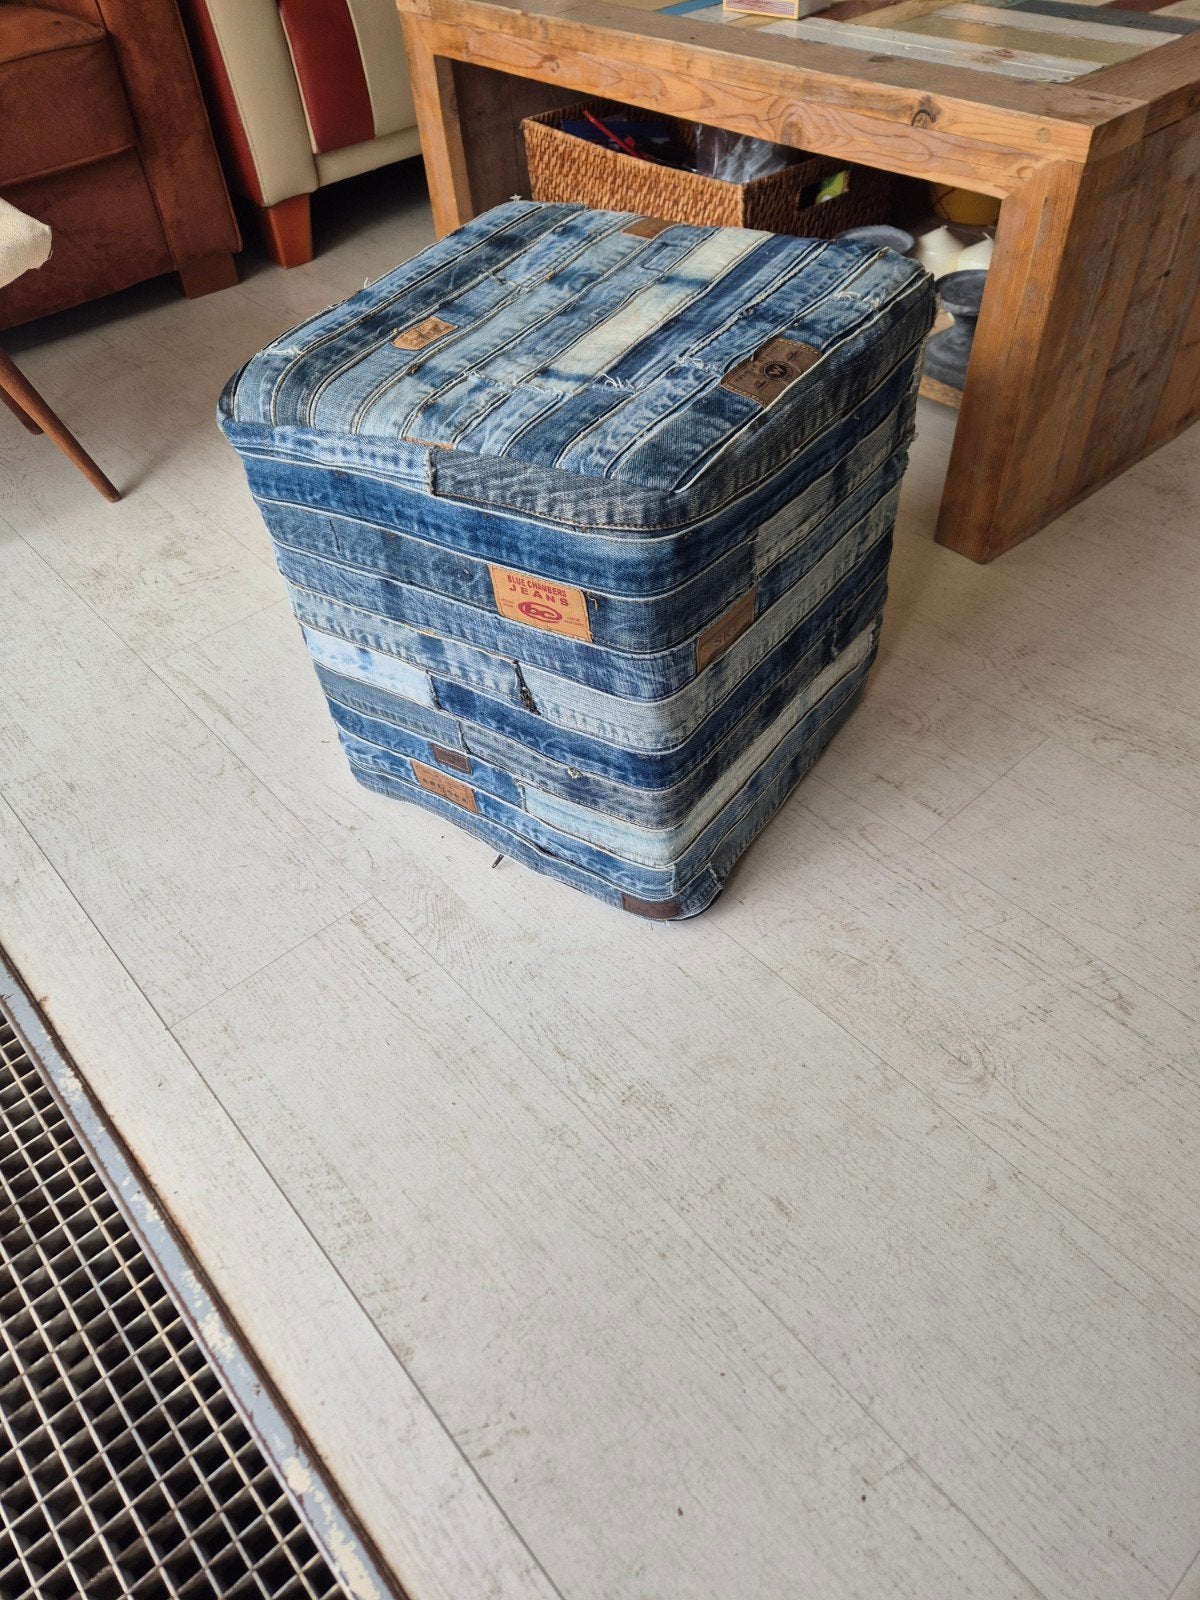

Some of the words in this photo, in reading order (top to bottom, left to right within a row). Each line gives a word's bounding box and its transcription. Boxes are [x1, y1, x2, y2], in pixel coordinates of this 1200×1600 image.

[507, 574, 527, 587] BLUE
[527, 580, 567, 598] CHAMBERS
[509, 584, 569, 607] JEANS
